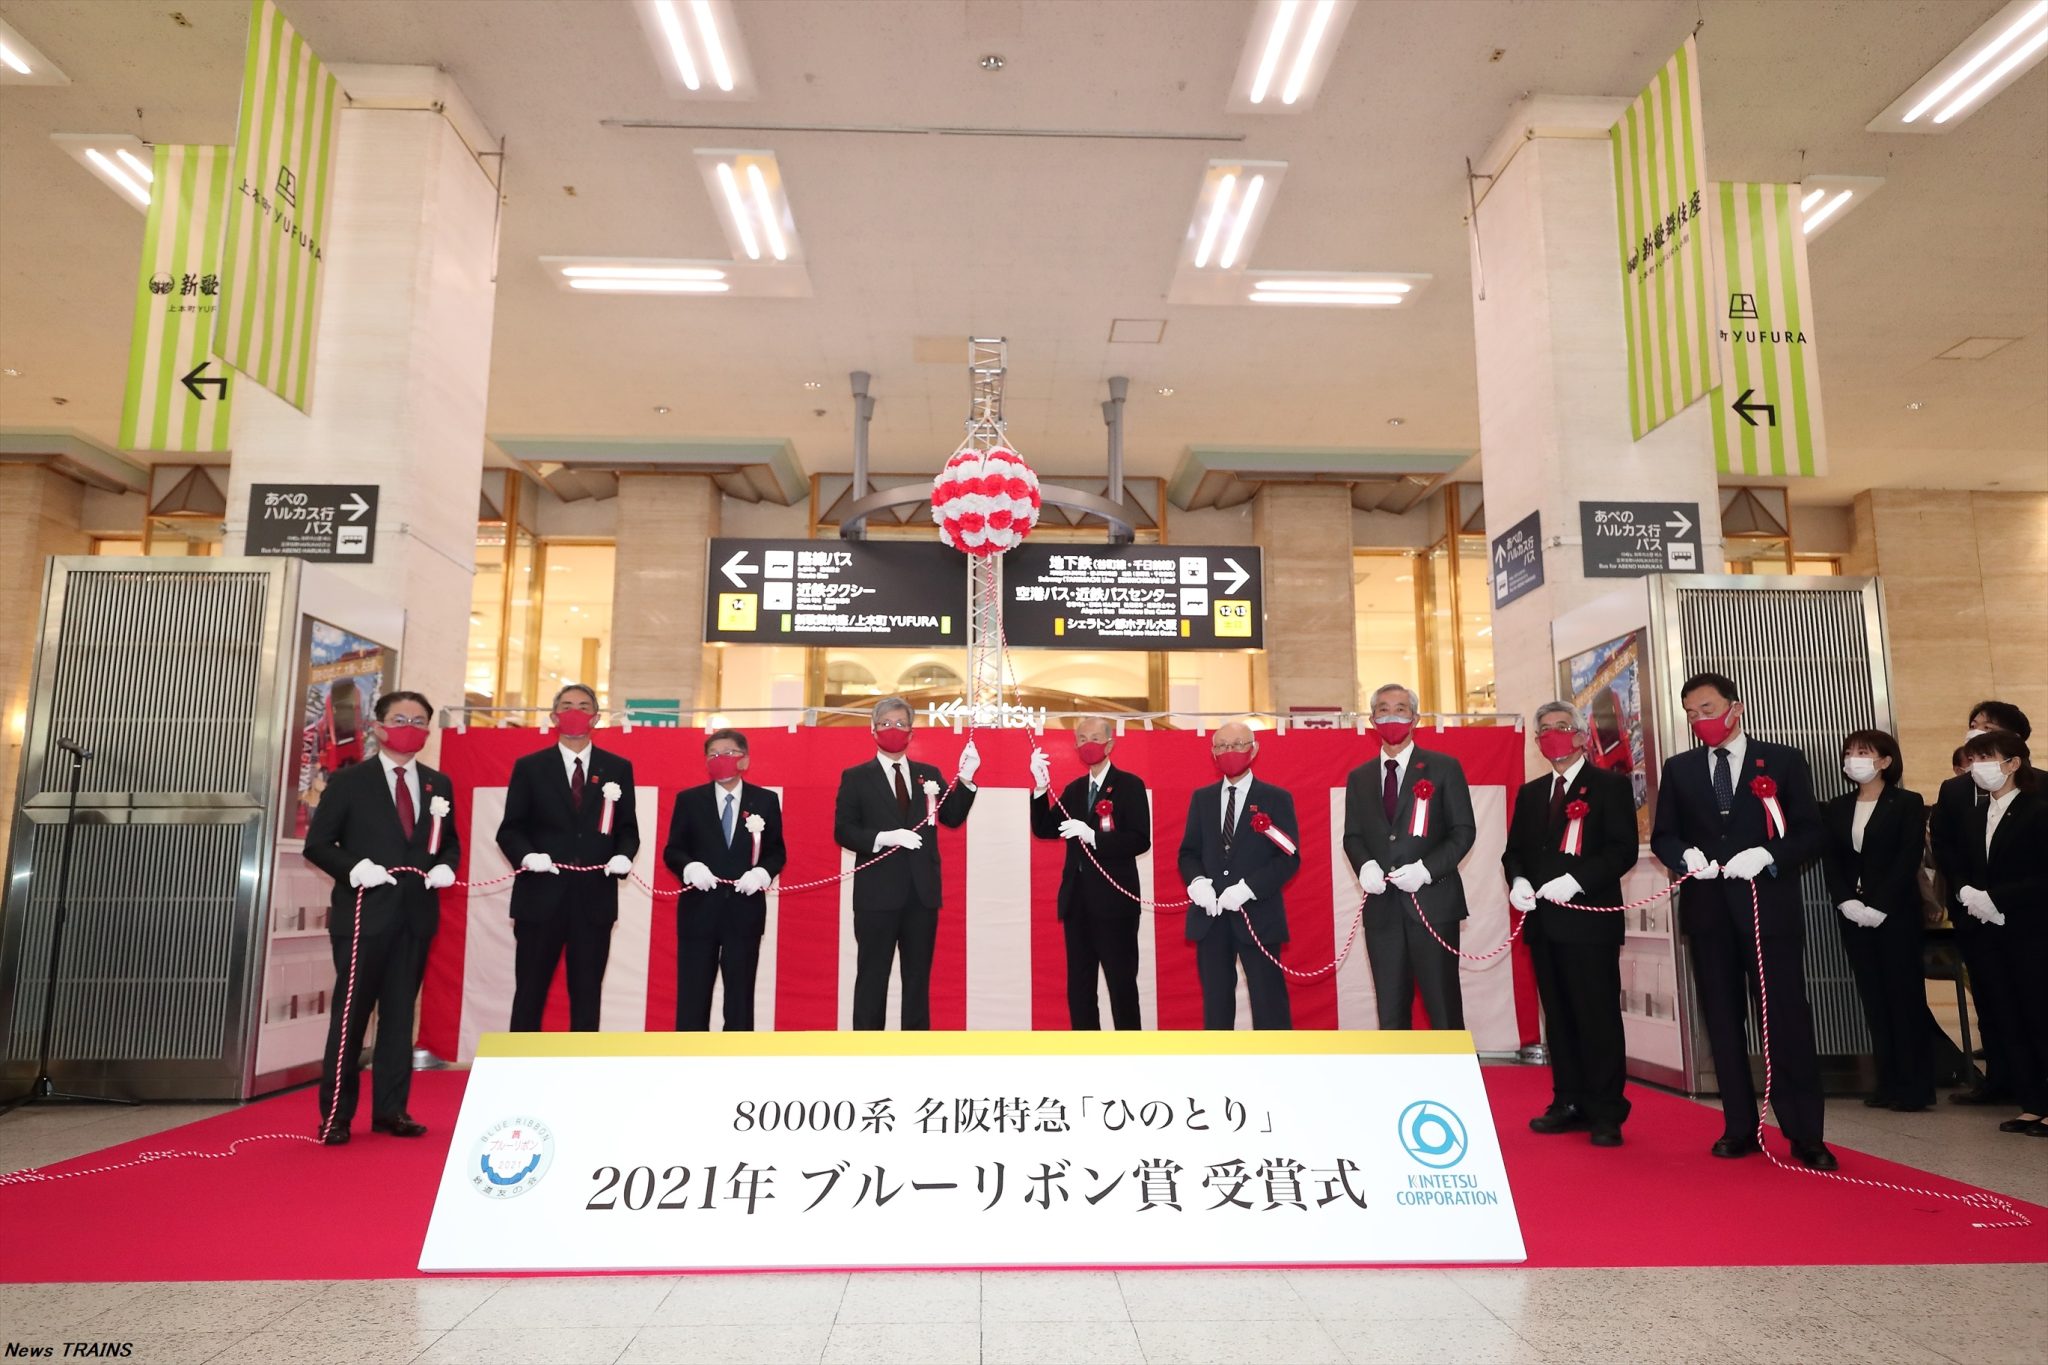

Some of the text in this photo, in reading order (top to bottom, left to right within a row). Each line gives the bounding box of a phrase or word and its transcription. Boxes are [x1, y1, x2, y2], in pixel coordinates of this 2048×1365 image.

[274, 209, 321, 261] YUFURA
[1732, 330, 1807, 344] YUFURA
[264, 492, 308, 506] あべの
[264, 507, 335, 520] ハルカス行
[1594, 510, 1634, 523] あべの
[304, 521, 333, 534] バス
[1596, 523, 1661, 538] ハルカス行
[1636, 538, 1663, 551] バス
[796, 583, 876, 598] 近鉄タクシー
[1015, 586, 1178, 602] 空港バス・近鉄バスセンター
[889, 616, 938, 627] YUFURA
[732, 1096, 1272, 1134] 80000系 名阪特急「ひのとり」
[481, 1118, 551, 1143] BLUE RIBBON
[489, 1139, 539, 1152] ブルーリボン
[585, 1157, 1369, 1215] 2021年 ブルーリボン賞 受賞式
[1407, 1174, 1478, 1188] KINTETSU
[1396, 1191, 1498, 1206] CORPORATION
